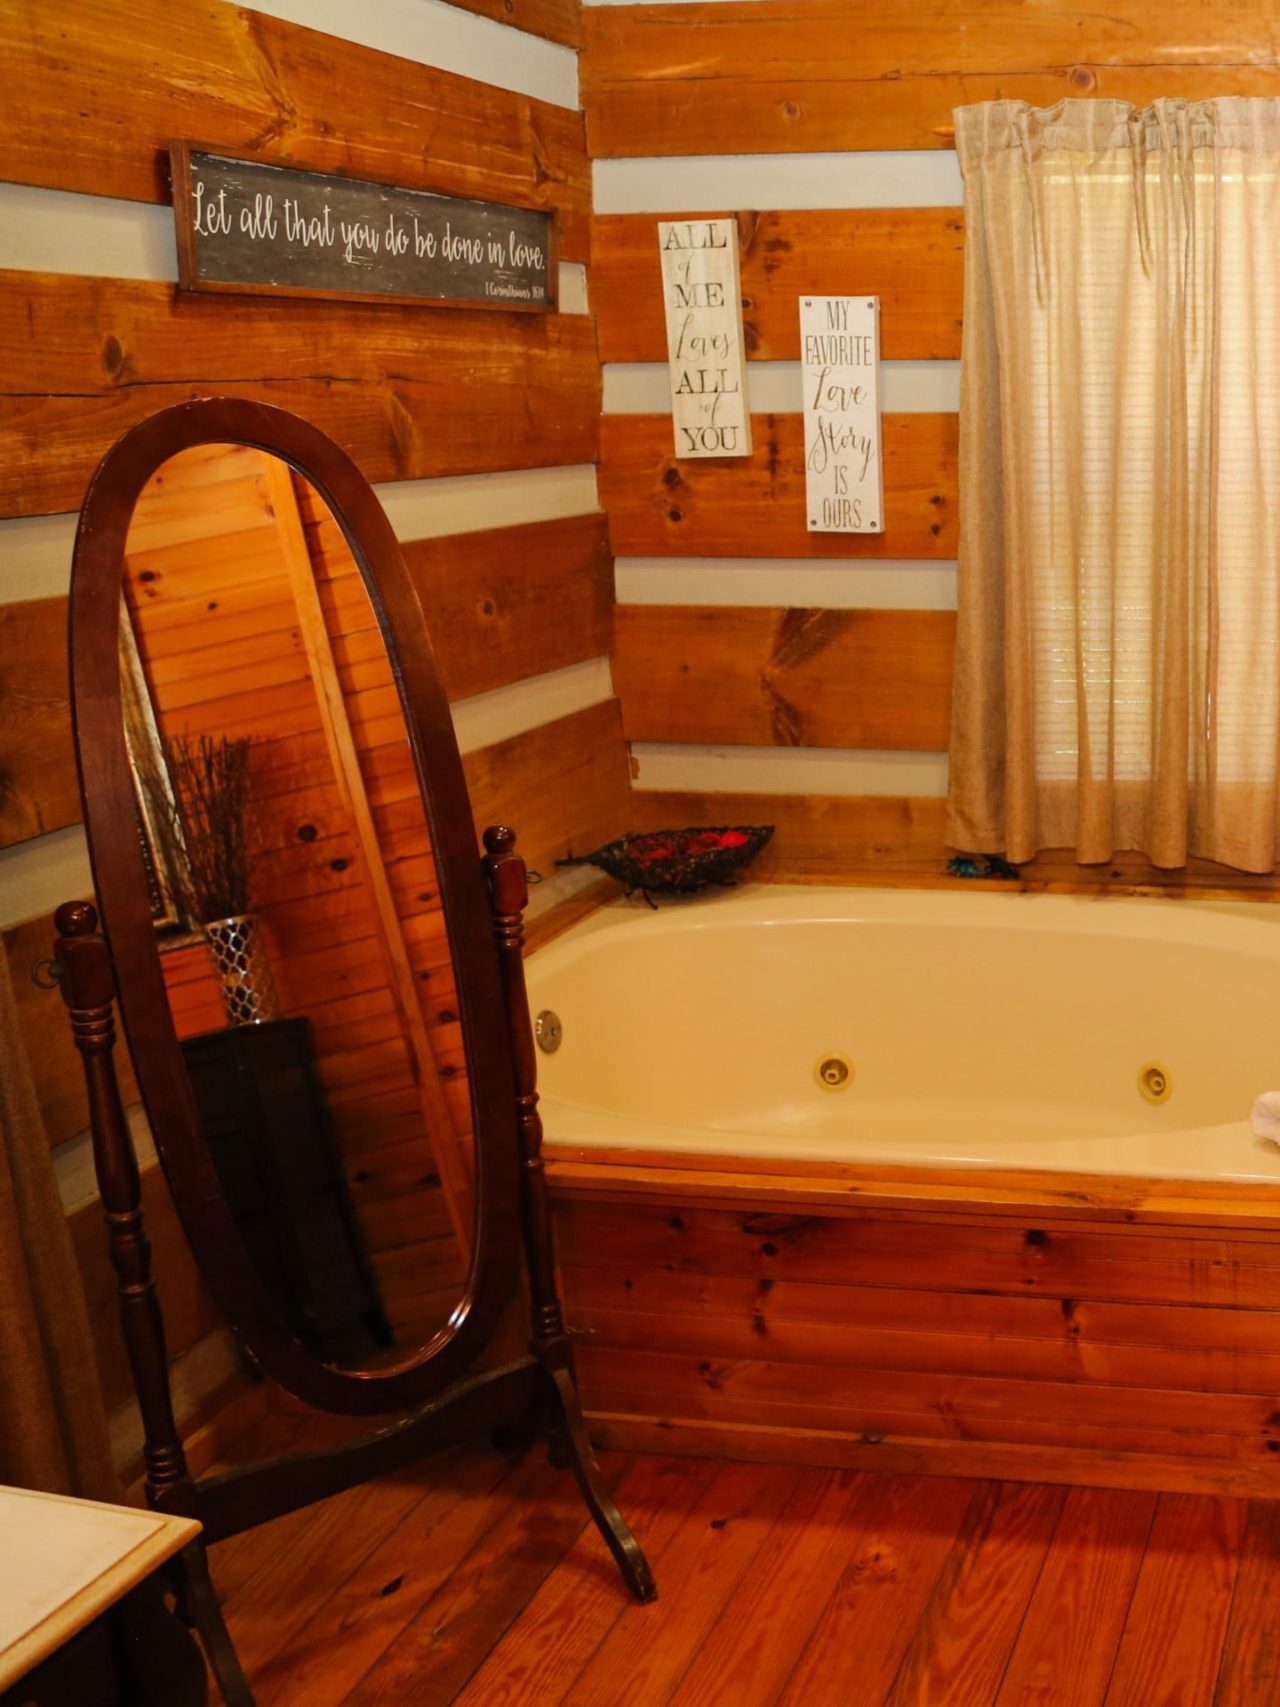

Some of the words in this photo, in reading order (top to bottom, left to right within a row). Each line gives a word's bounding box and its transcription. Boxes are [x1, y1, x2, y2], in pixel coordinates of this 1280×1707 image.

[191, 181, 232, 237] Let
[240, 193, 277, 241] all
[284, 199, 335, 248] that
[340, 221, 379, 263] you
[385, 214, 409, 256] do
[414, 218, 438, 258] be
[441, 222, 484, 265] done
[487, 231, 506, 268] in
[509, 230, 546, 271] love.
[663, 223, 727, 250] ALL
[673, 283, 724, 308] ME
[827, 301, 850, 330] MY
[676, 313, 734, 361] Loves
[805, 335, 872, 366] FAVORITE
[675, 369, 738, 395] ALL
[812, 367, 867, 412] Love
[680, 426, 738, 451] YOU
[807, 415, 875, 482] Story
[834, 465, 848, 495] IS
[823, 499, 861, 528] OURS
